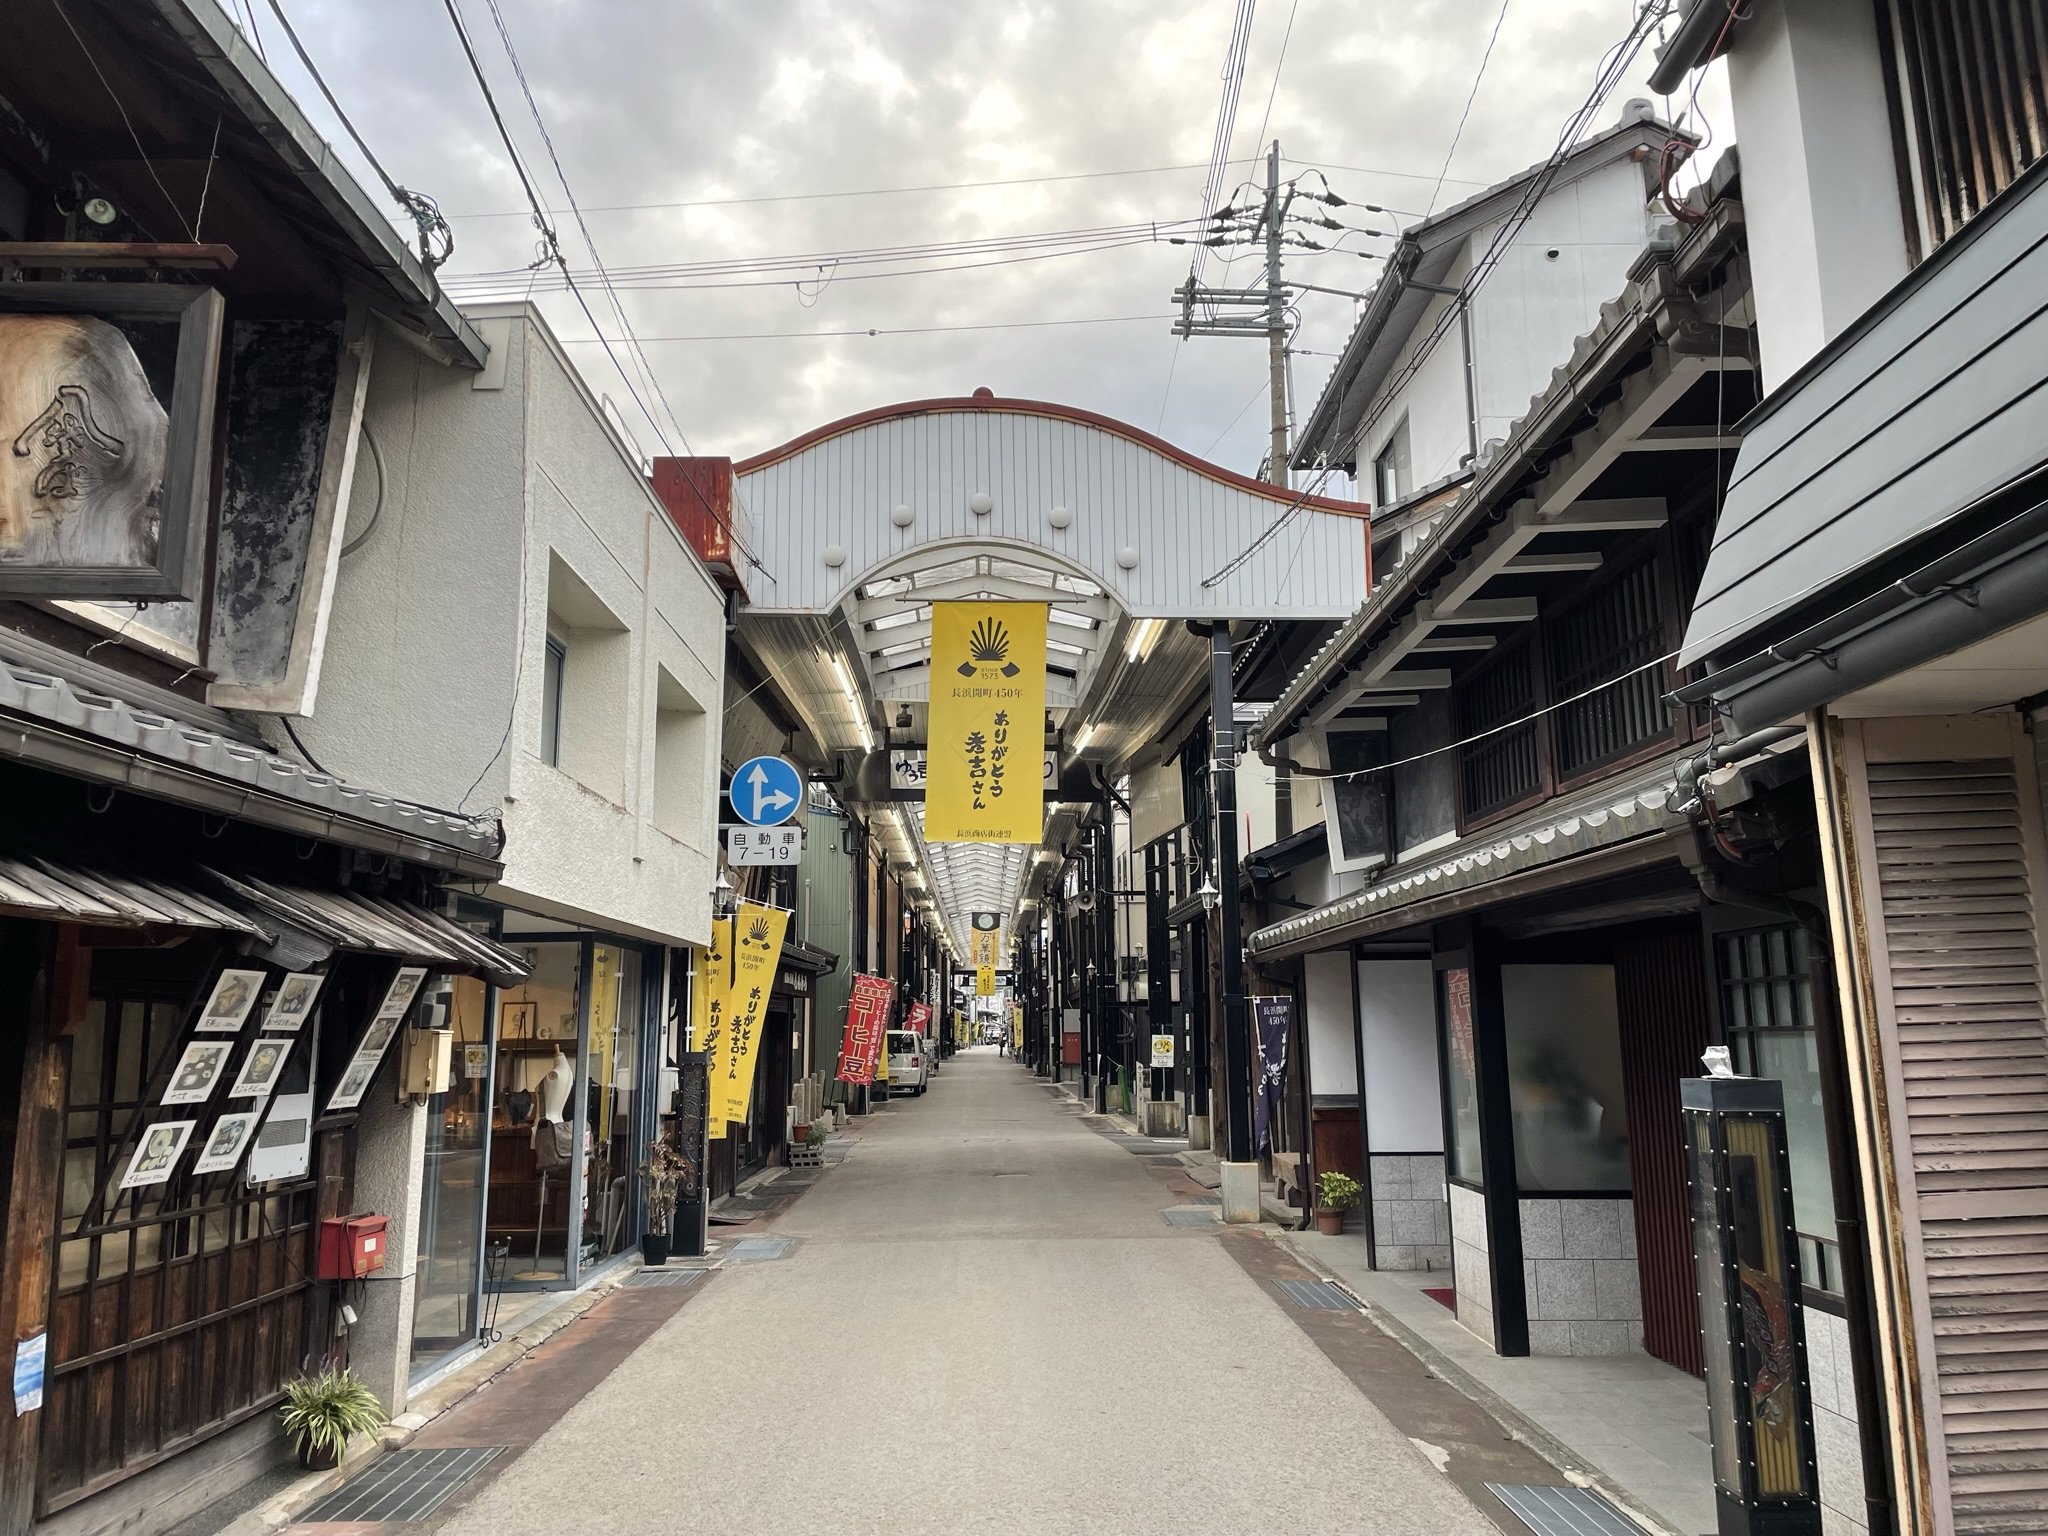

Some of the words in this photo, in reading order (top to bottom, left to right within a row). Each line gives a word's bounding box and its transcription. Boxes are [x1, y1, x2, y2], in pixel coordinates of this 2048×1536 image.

[952, 687, 992, 698] 長浜開町
[964, 730, 988, 810] 秀吉さん
[989, 709, 1010, 798] ありがとう
[734, 832, 795, 845] 自動車
[740, 986, 761, 1056] ありがとう
[842, 995, 875, 1077] コーヒー豆
